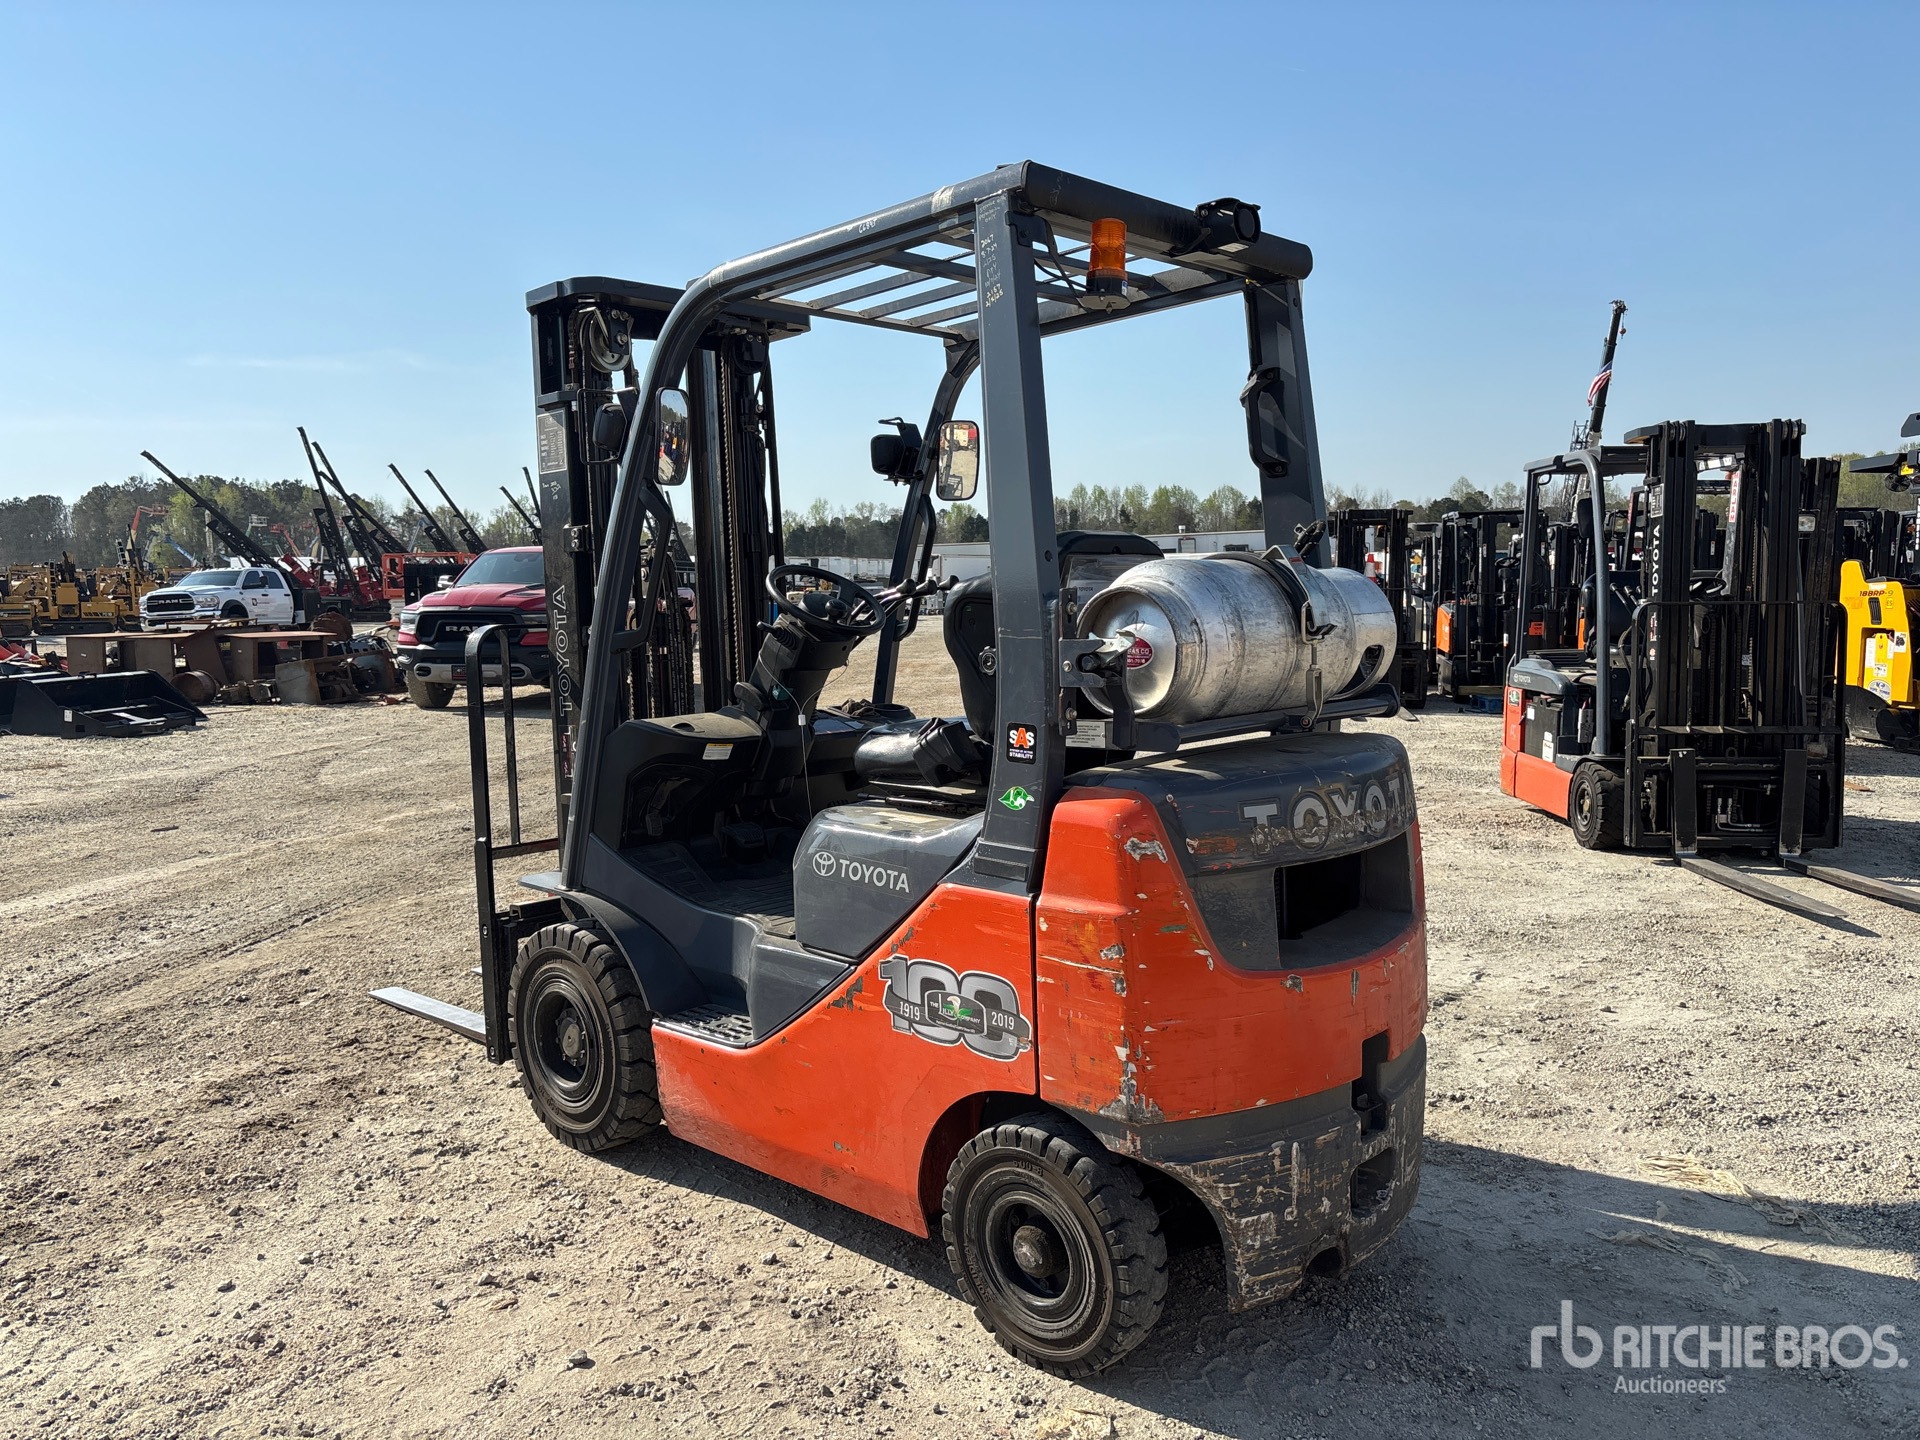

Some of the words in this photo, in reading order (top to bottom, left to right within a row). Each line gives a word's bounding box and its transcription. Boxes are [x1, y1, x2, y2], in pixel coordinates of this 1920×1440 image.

[1651, 524, 1661, 597] TOYOTA
[552, 584, 573, 717] TOYOTA
[1518, 674, 1531, 683] TOYOTA
[1009, 727, 1035, 749] SAS
[1009, 751, 1034, 760] STABILITY
[839, 858, 910, 894] TOYOTA
[899, 1001, 920, 1021] 1919
[991, 1011, 1015, 1030] 2019
